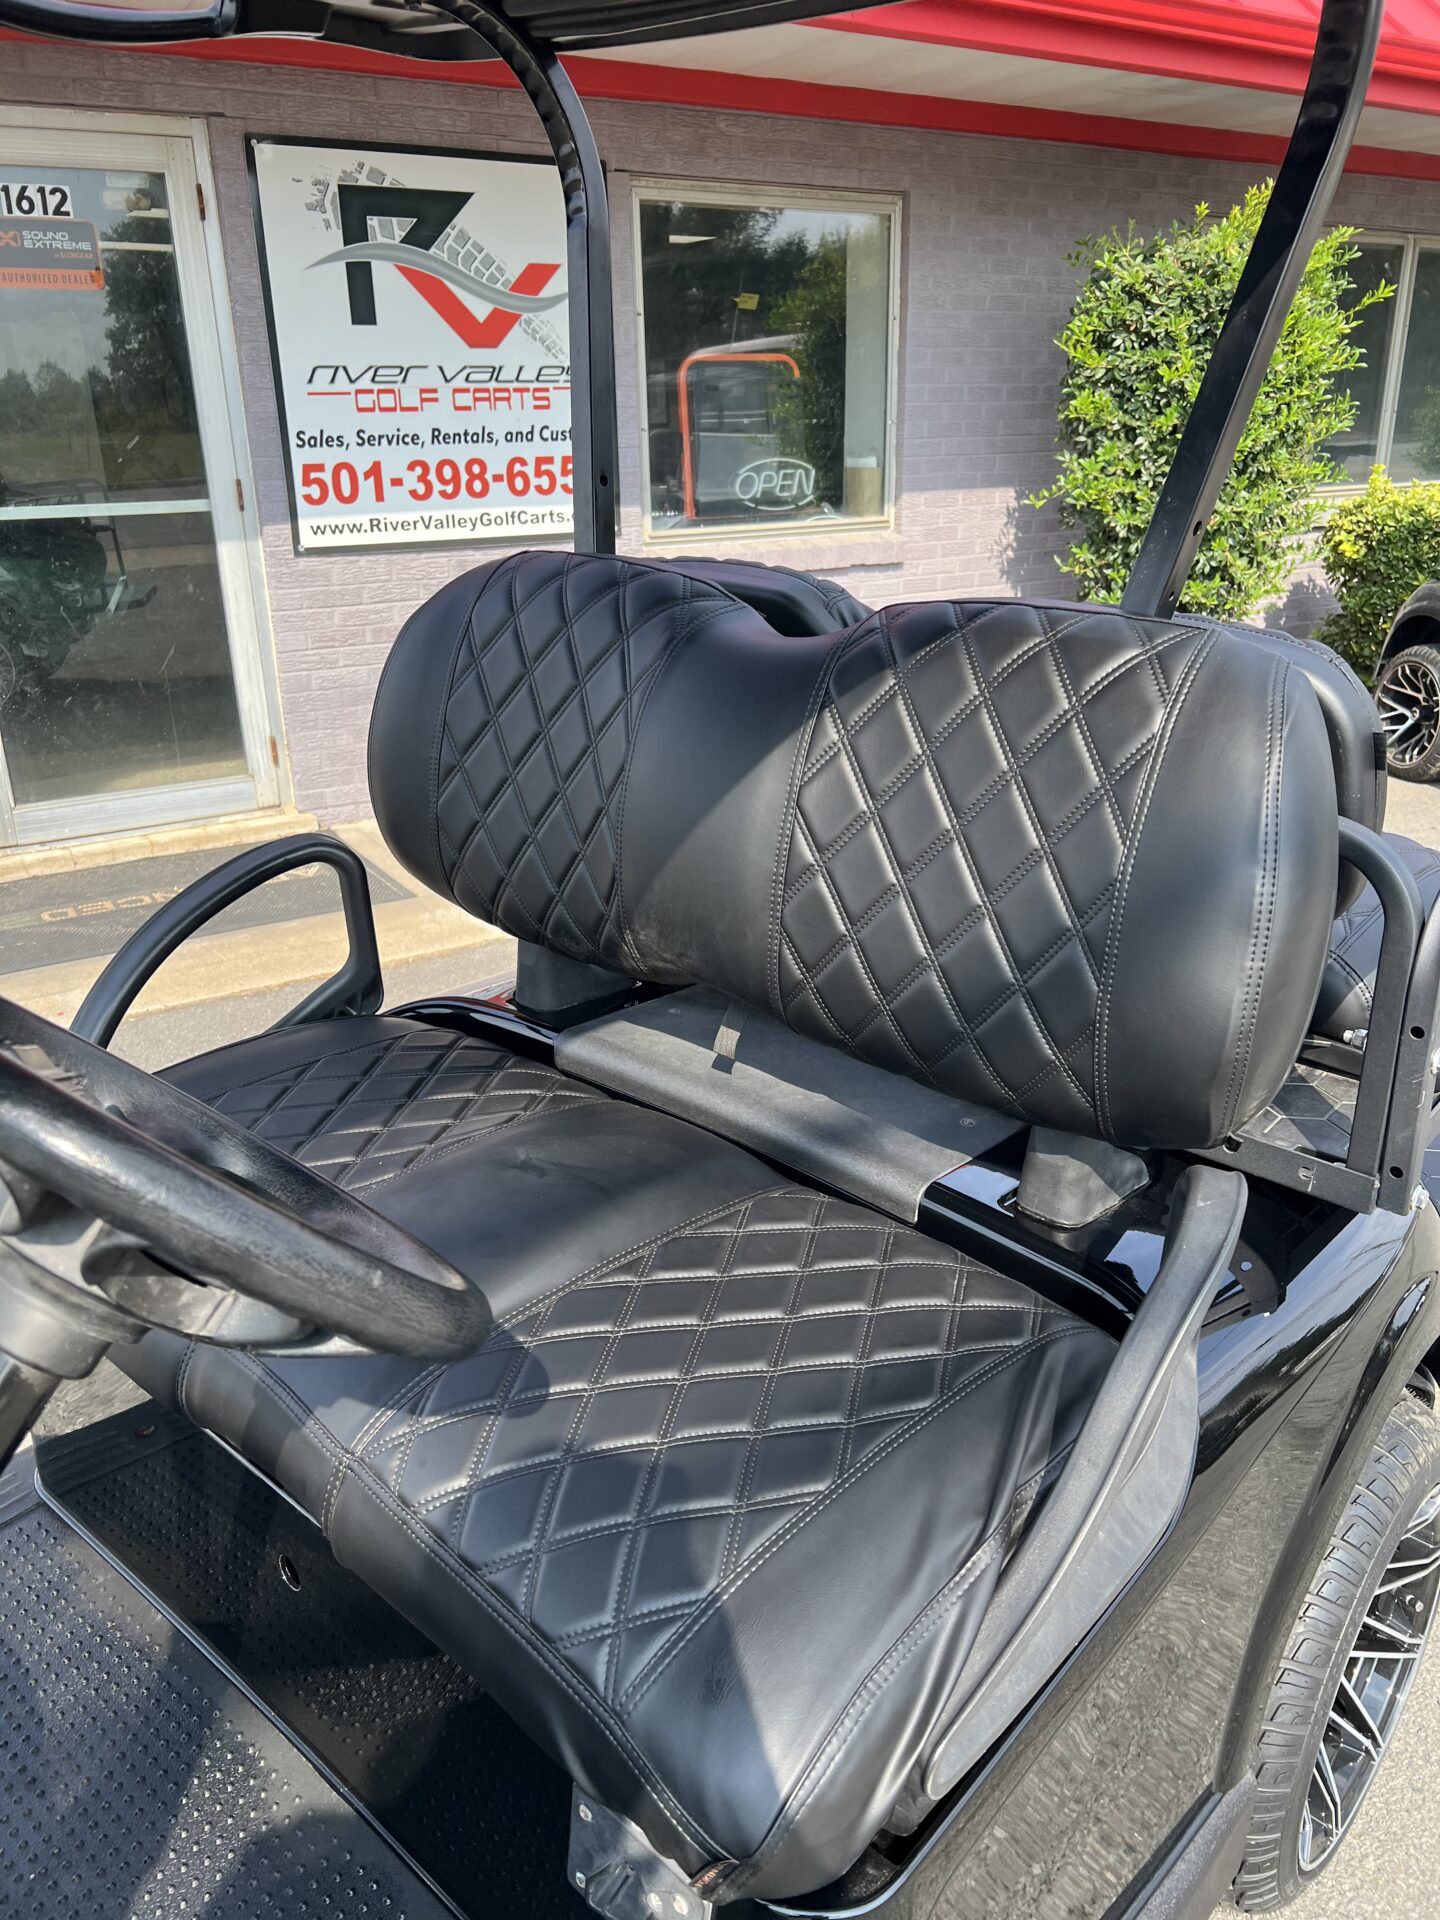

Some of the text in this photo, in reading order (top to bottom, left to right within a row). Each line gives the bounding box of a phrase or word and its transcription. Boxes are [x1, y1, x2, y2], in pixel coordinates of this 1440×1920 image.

[0, 184, 71, 217] 1612
[22, 230, 69, 241] SOUND
[23, 239, 92, 251] EXTREME
[1, 271, 96, 285] AUTHORIZED DEALER
[437, 364, 571, 384] valle
[354, 386, 551, 413] GOLF CARTS
[296, 424, 573, 451] Sales, Service, Rentals, and Cust
[301, 455, 573, 506] 501-398-655
[736, 468, 815, 500] OPEN
[309, 508, 574, 537] www.RiverValleyGolfCarts.
